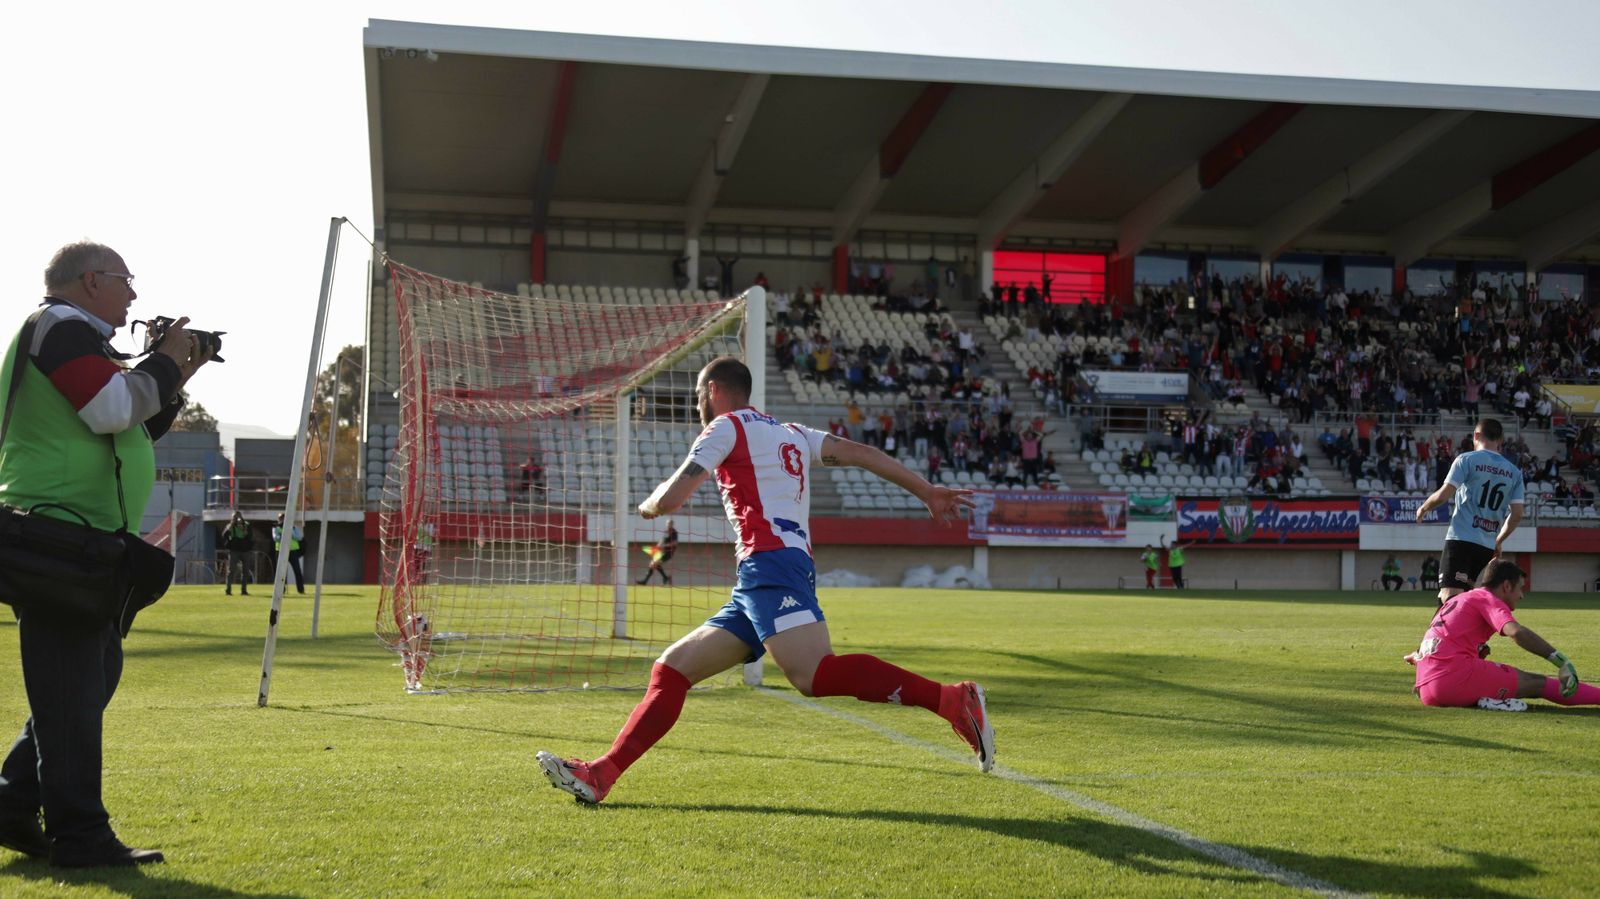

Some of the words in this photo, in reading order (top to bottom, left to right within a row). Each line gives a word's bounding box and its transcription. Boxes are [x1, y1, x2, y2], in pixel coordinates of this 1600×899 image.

[1475, 464, 1514, 479] NISSAN
[1477, 479, 1507, 512] 16
[1179, 501, 1220, 543] Soy
[1254, 500, 1360, 544] Algecirista
